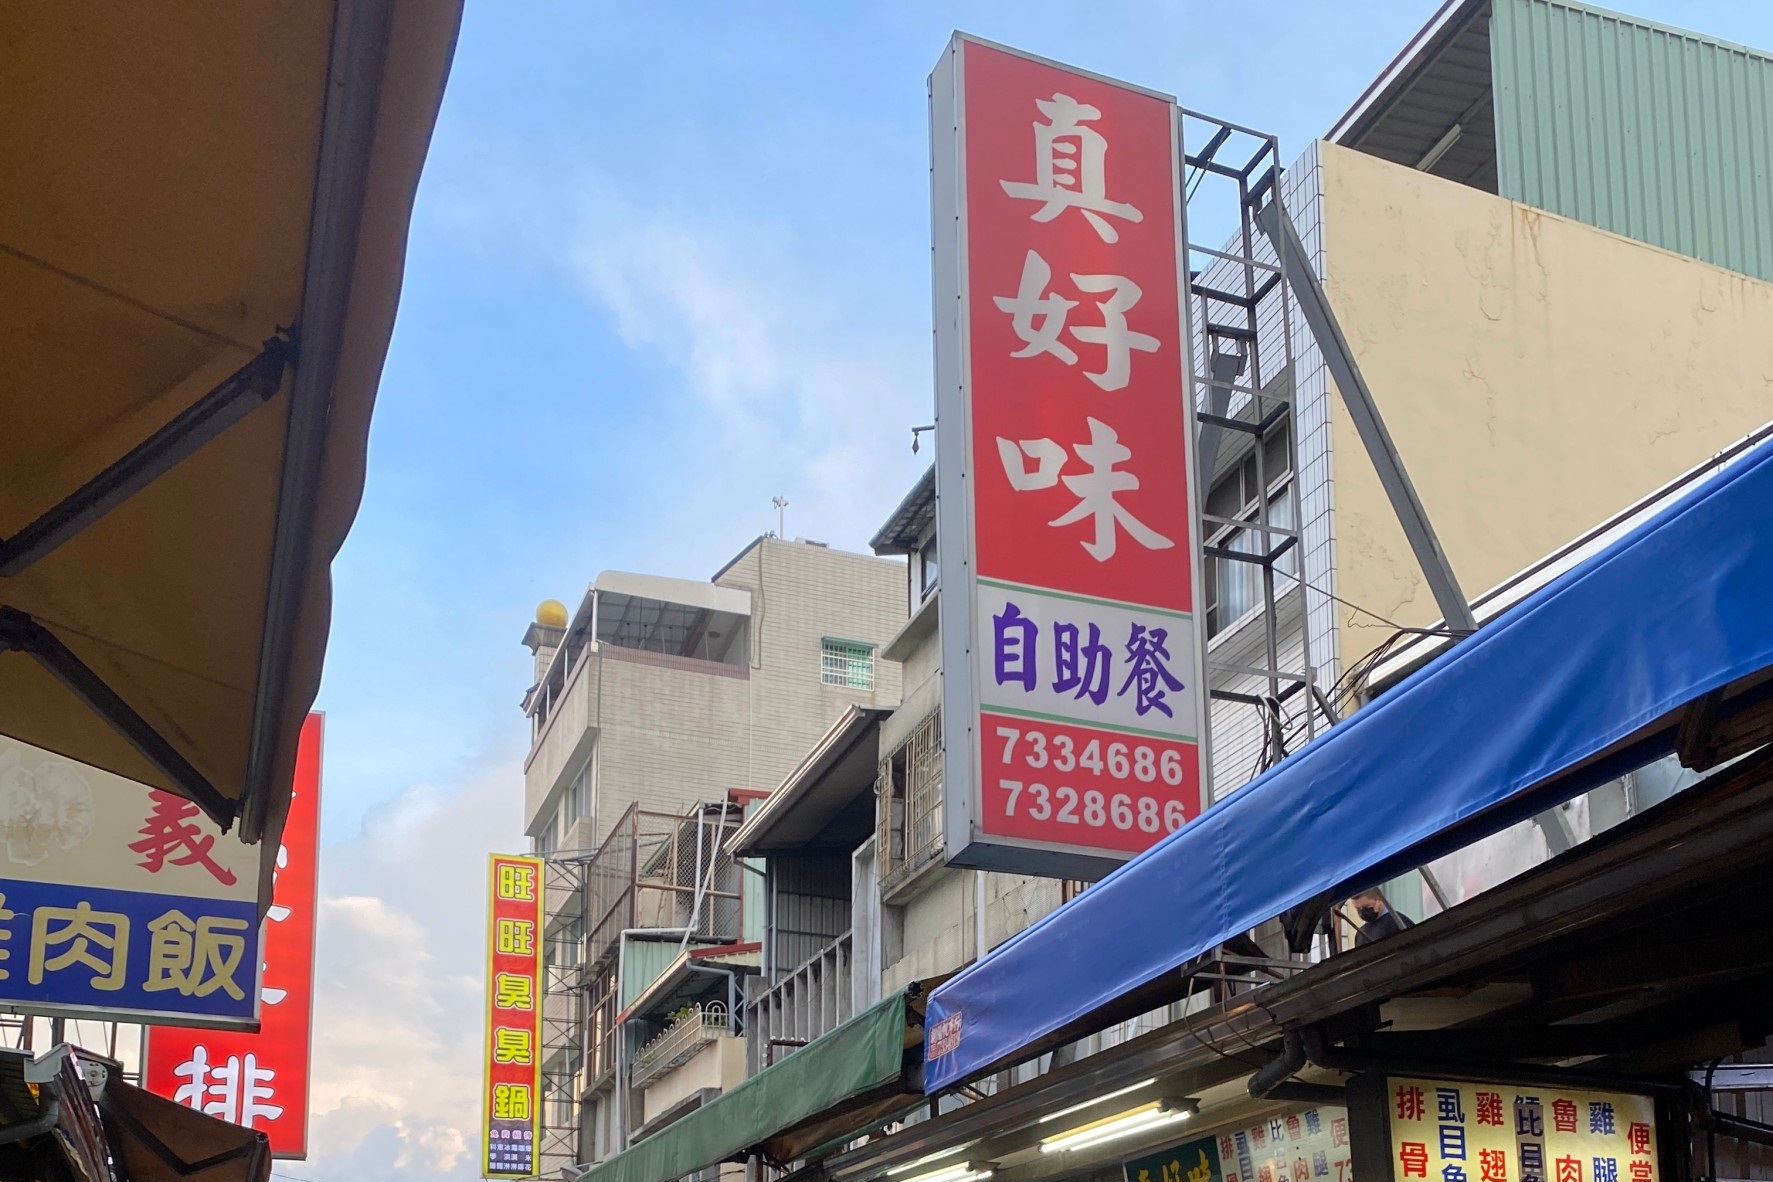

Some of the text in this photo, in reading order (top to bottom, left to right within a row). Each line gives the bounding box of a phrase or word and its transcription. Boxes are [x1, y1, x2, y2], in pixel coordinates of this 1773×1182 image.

[993, 92, 1175, 562] 真好味
[991, 602, 1184, 719] 自助餐
[995, 727, 1183, 786] 7334686
[999, 778, 1186, 836] 7328686
[127, 788, 237, 886] 義
[494, 864, 534, 1121] 旺旺臭臭鍋
